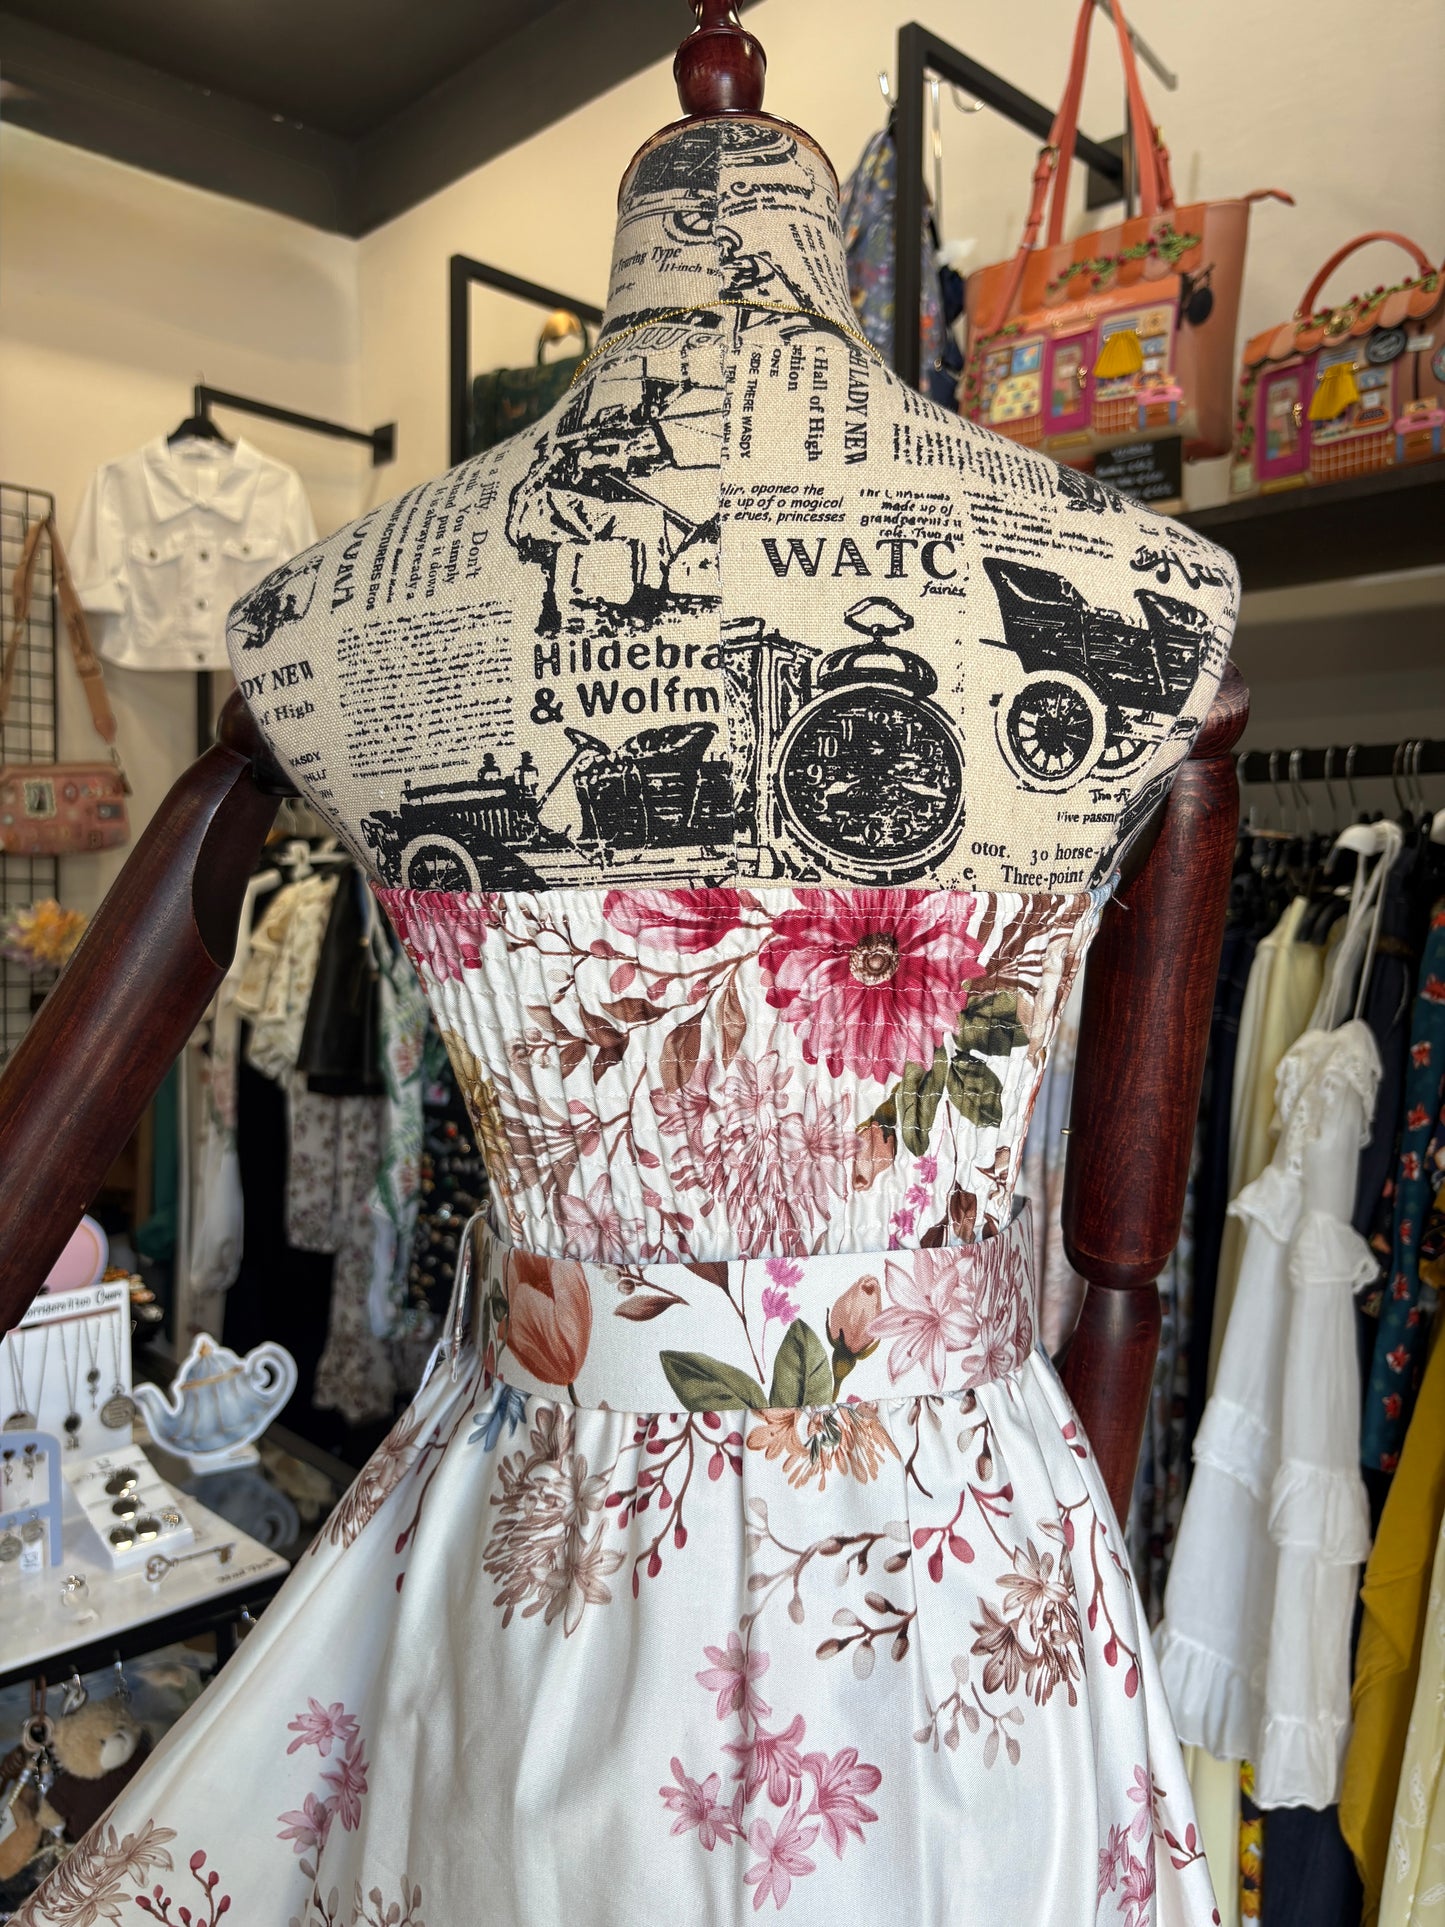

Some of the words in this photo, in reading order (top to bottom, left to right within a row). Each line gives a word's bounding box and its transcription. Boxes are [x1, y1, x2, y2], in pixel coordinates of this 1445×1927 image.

[651, 246, 683, 263] Type
[749, 351, 762, 375] SIDE
[770, 348, 782, 378] ONE
[812, 358, 829, 391] Hall
[742, 379, 758, 413] THERE
[809, 395, 825, 414] of
[804, 417, 825, 462] High
[844, 421, 868, 465] NEW
[474, 481, 500, 516] jiffy.
[737, 498, 755, 511] up
[756, 494, 777, 511] of
[803, 483, 825, 496] the
[453, 503, 473, 533] You
[775, 510, 847, 526] princesses
[880, 500, 916, 513] made
[919, 504, 937, 516] up
[434, 514, 450, 541] puts
[431, 546, 446, 558] it
[441, 538, 463, 585] simply
[465, 528, 489, 580] Don't
[761, 537, 958, 580] WATC
[425, 561, 443, 600] down
[365, 583, 381, 612] Bros
[534, 636, 724, 680] Hildebra
[271, 660, 314, 691] NEW
[273, 700, 315, 720] High
[530, 687, 564, 725] &
[577, 676, 721, 718] Wolfm
[970, 841, 1011, 859] otor.
[1030, 850, 1049, 867] 30
[1000, 864, 1084, 891] Three-point
